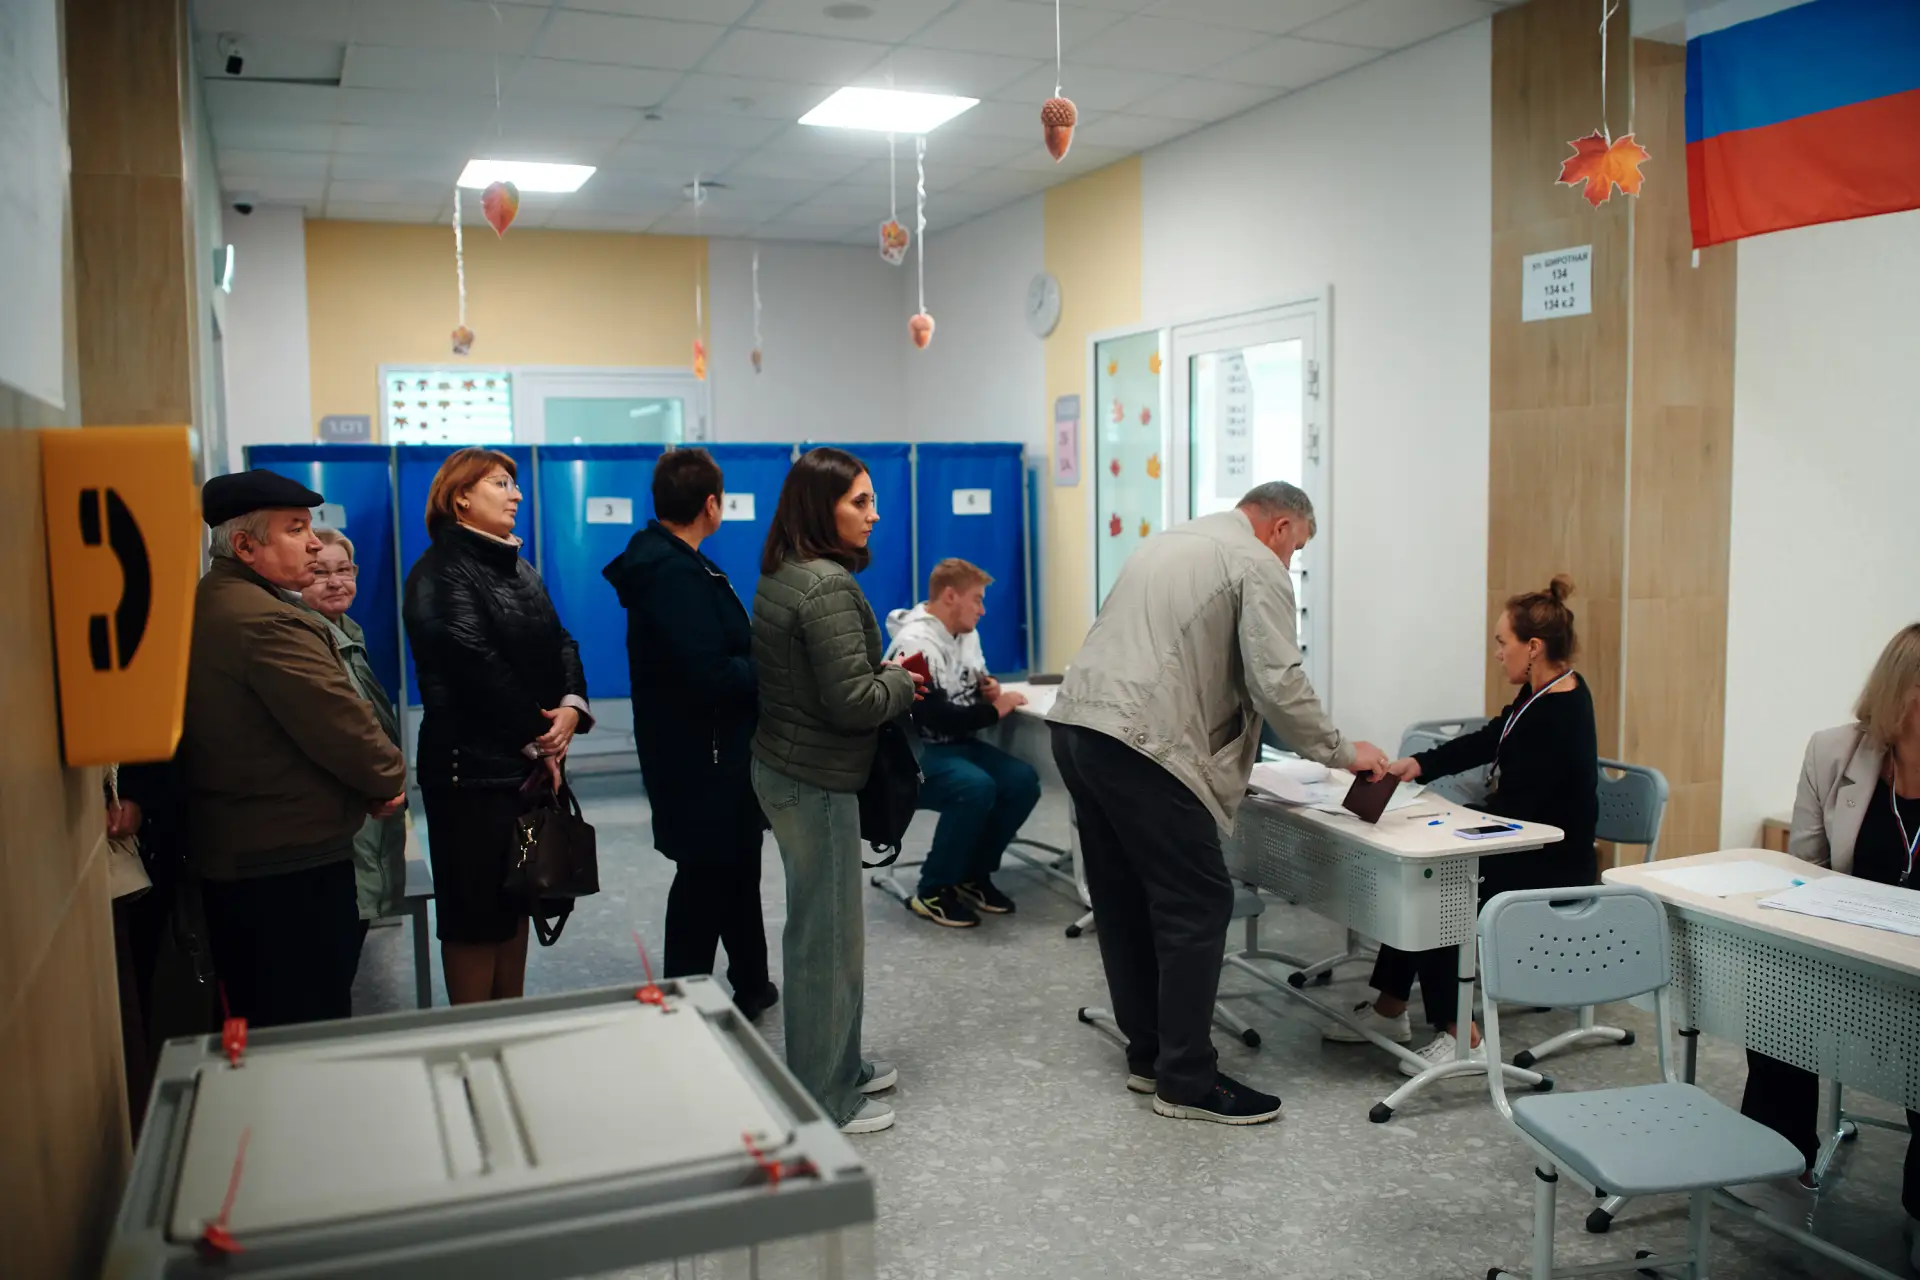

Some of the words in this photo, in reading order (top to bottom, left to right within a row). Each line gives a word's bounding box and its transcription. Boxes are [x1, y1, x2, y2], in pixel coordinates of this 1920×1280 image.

[1544, 252, 1588, 268] ШИРОТНАЯ
[1552, 268, 1568, 280] 134
[1544, 284, 1560, 295] 134
[1544, 298, 1559, 310] 134
[604, 503, 614, 517] 3
